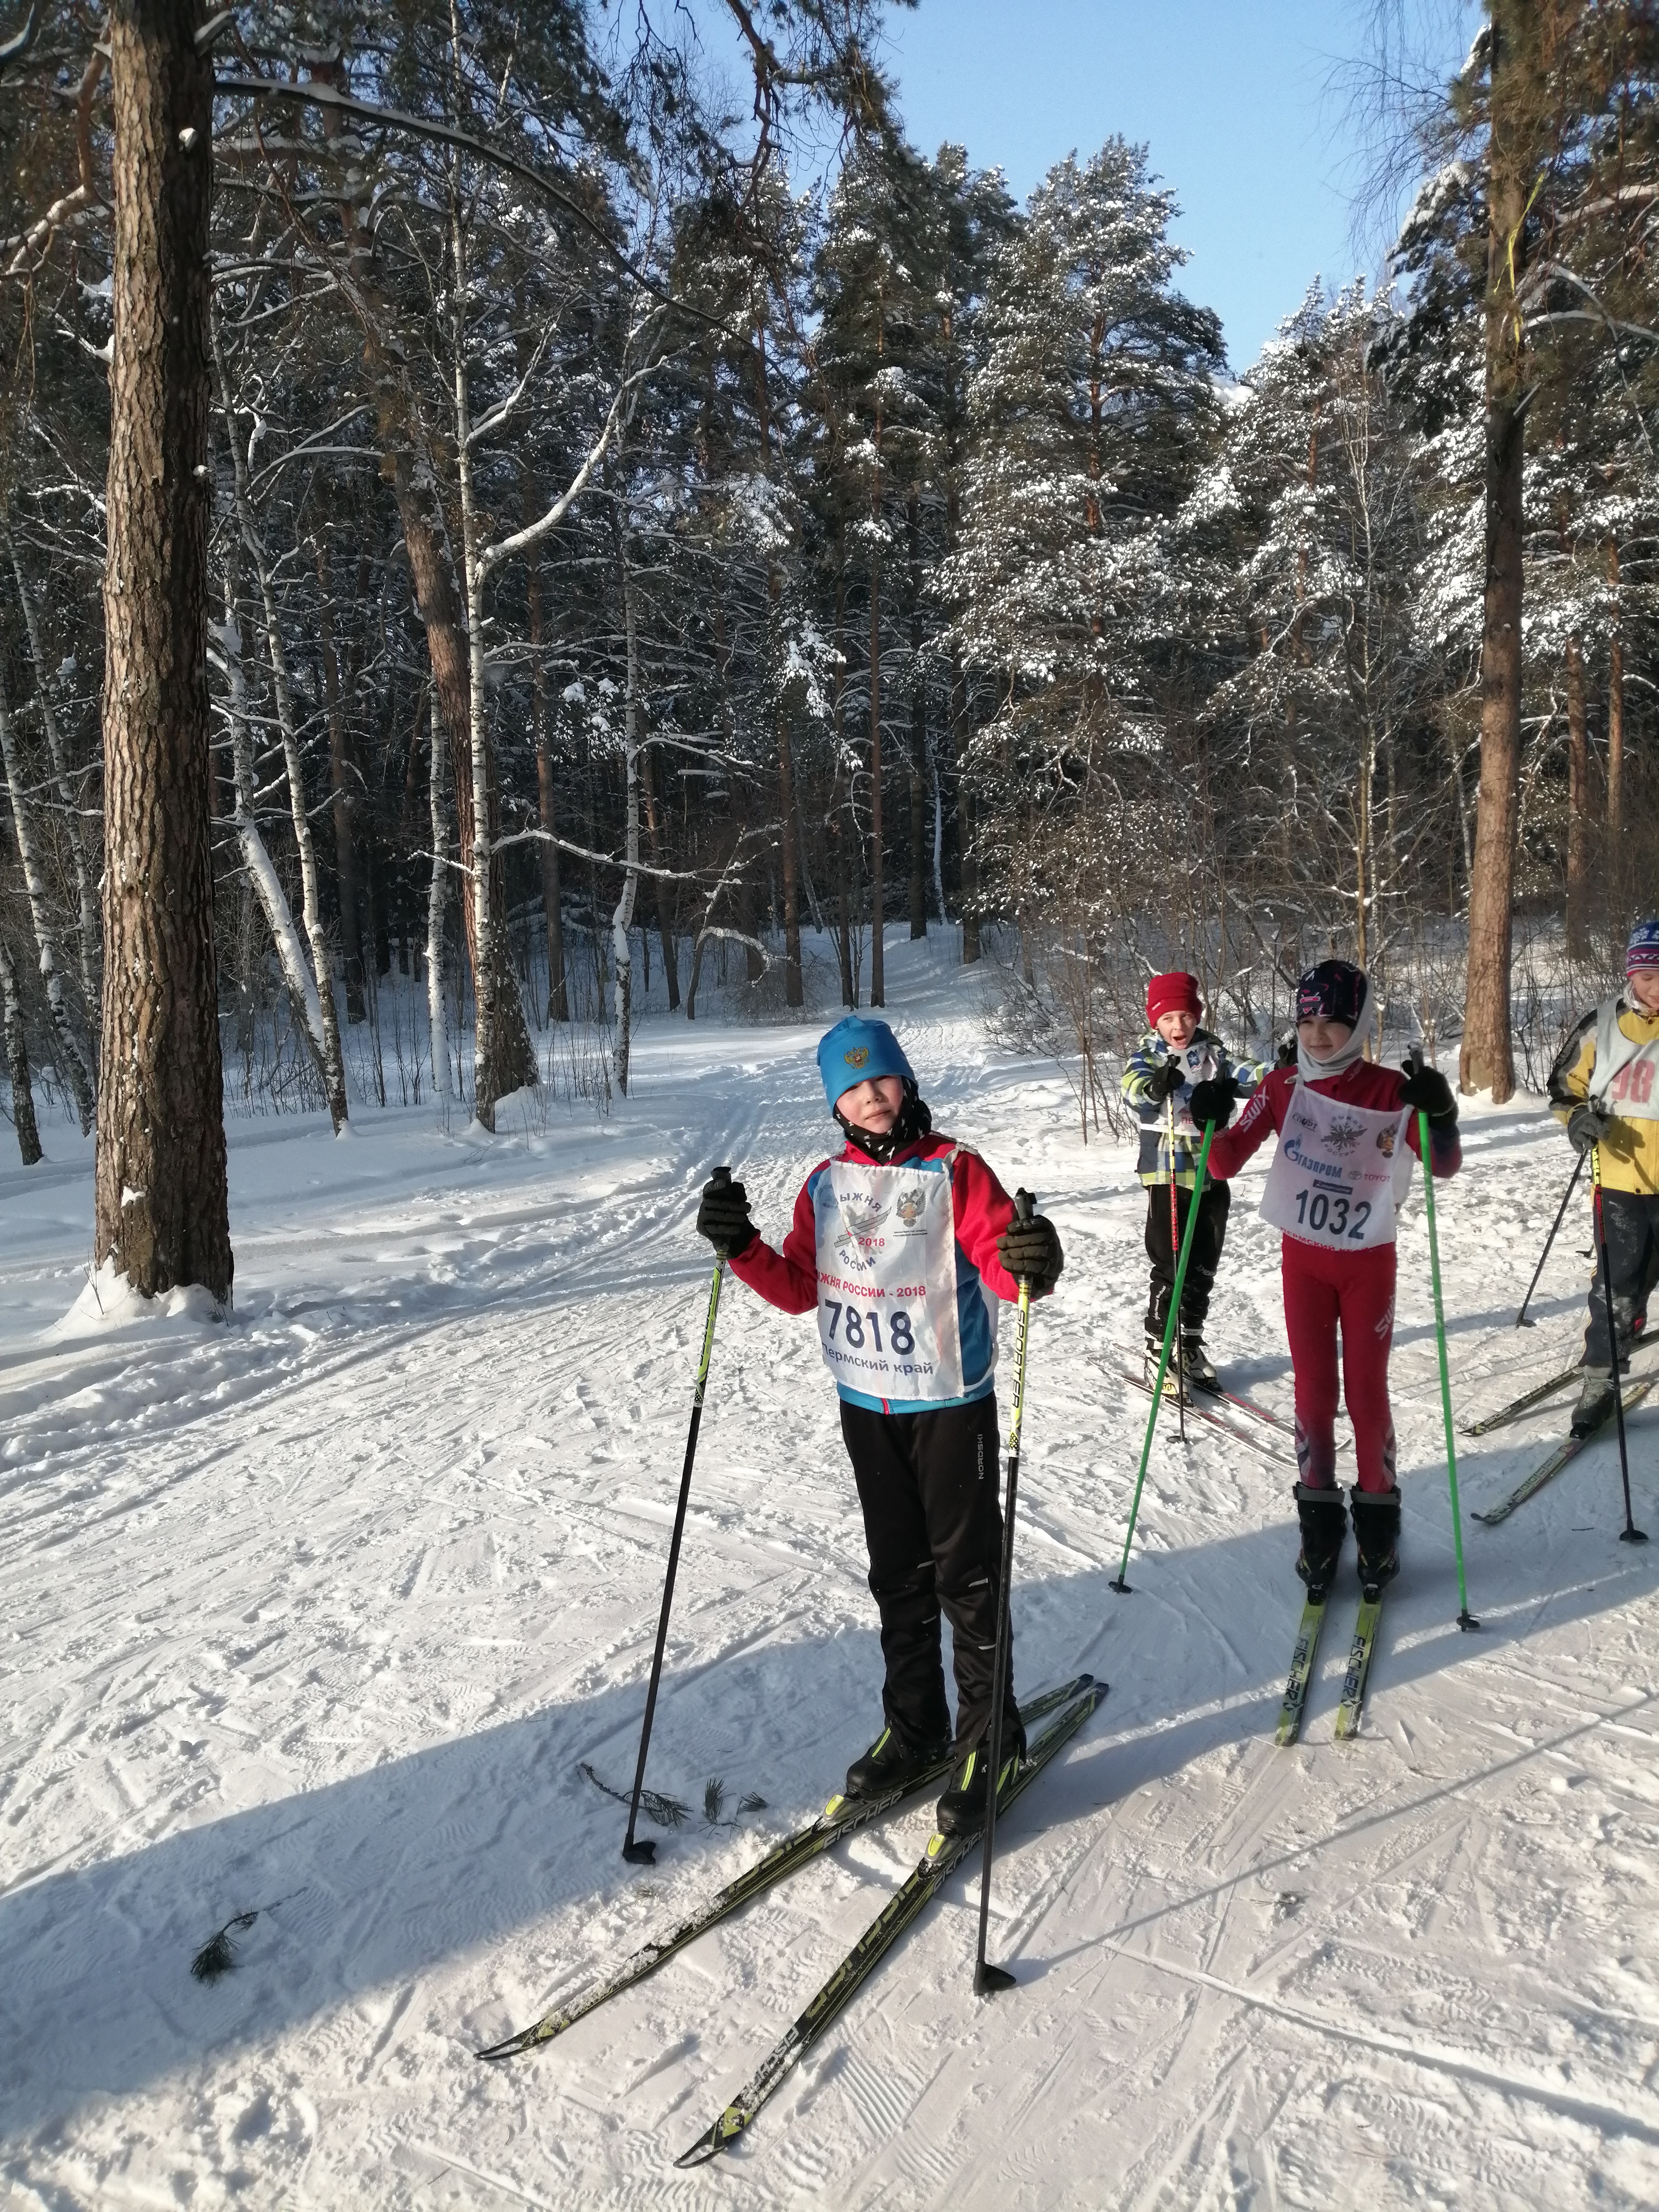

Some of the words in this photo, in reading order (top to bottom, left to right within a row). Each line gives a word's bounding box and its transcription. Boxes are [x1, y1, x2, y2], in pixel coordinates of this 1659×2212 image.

[1297, 1153, 1343, 1178] ГАЗПРОМ
[1364, 1174, 1391, 1182] TOYOT
[840, 1192, 883, 1212] ЫЖНЯ
[1296, 1189, 1372, 1239] 1032
[858, 1237, 885, 1247] 2018
[839, 1250, 876, 1271] РОССИИ
[843, 1280, 885, 1297] РОССИИ
[896, 1286, 926, 1297] 2018
[825, 1298, 916, 1355] 7818
[822, 1342, 889, 1372] Пермский
[893, 1362, 934, 1376] край
[1285, 1637, 1309, 1700] FISCHER
[1343, 1635, 1367, 1698] FISCHER
[823, 1791, 903, 1849] FISCHER
